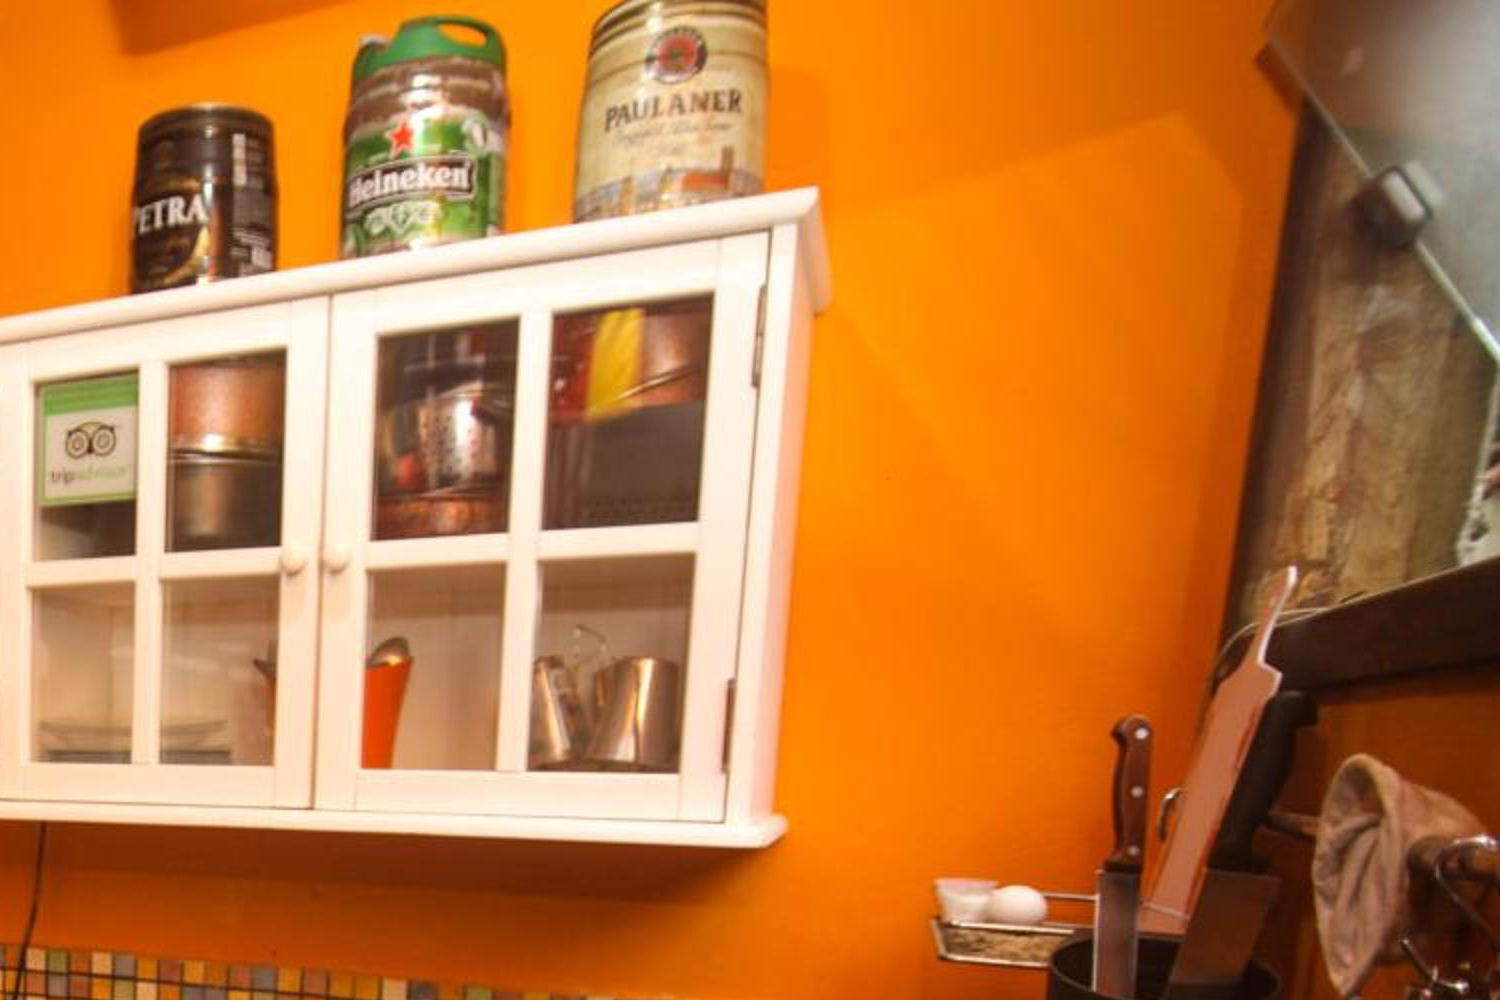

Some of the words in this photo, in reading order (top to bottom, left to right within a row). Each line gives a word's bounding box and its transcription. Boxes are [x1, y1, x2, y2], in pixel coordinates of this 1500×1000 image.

[604, 89, 742, 132] PAULANER
[349, 162, 471, 207] Heineken
[50, 465, 125, 484] tripadvr
